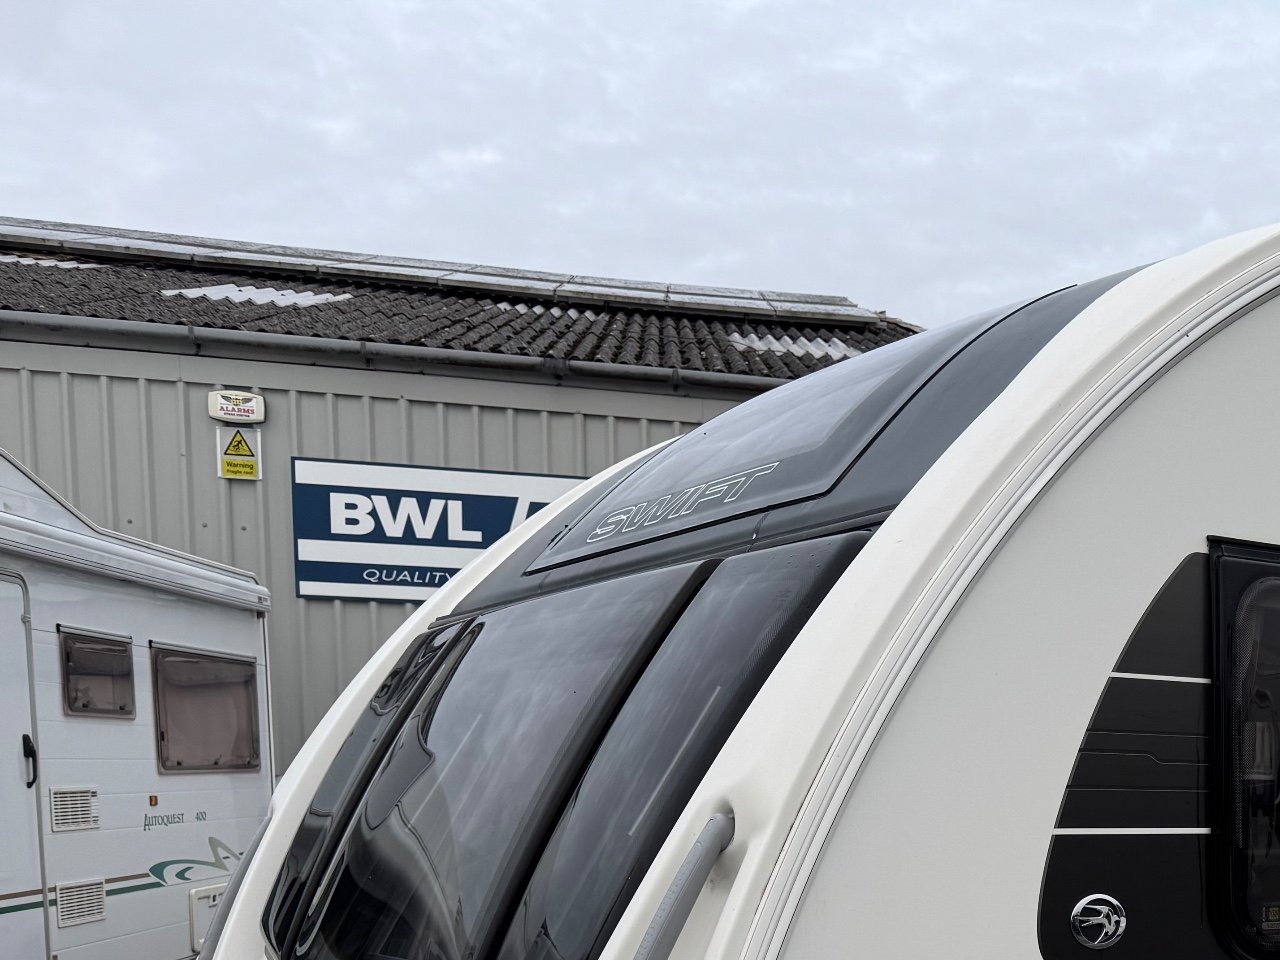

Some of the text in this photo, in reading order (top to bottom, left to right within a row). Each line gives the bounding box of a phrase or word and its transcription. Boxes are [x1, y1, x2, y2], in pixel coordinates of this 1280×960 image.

[219, 405, 255, 415] ALARMS
[225, 461, 254, 471] Warning
[587, 461, 781, 543] SWIFT
[329, 492, 483, 543] BWL
[195, 811, 207, 822] 400
